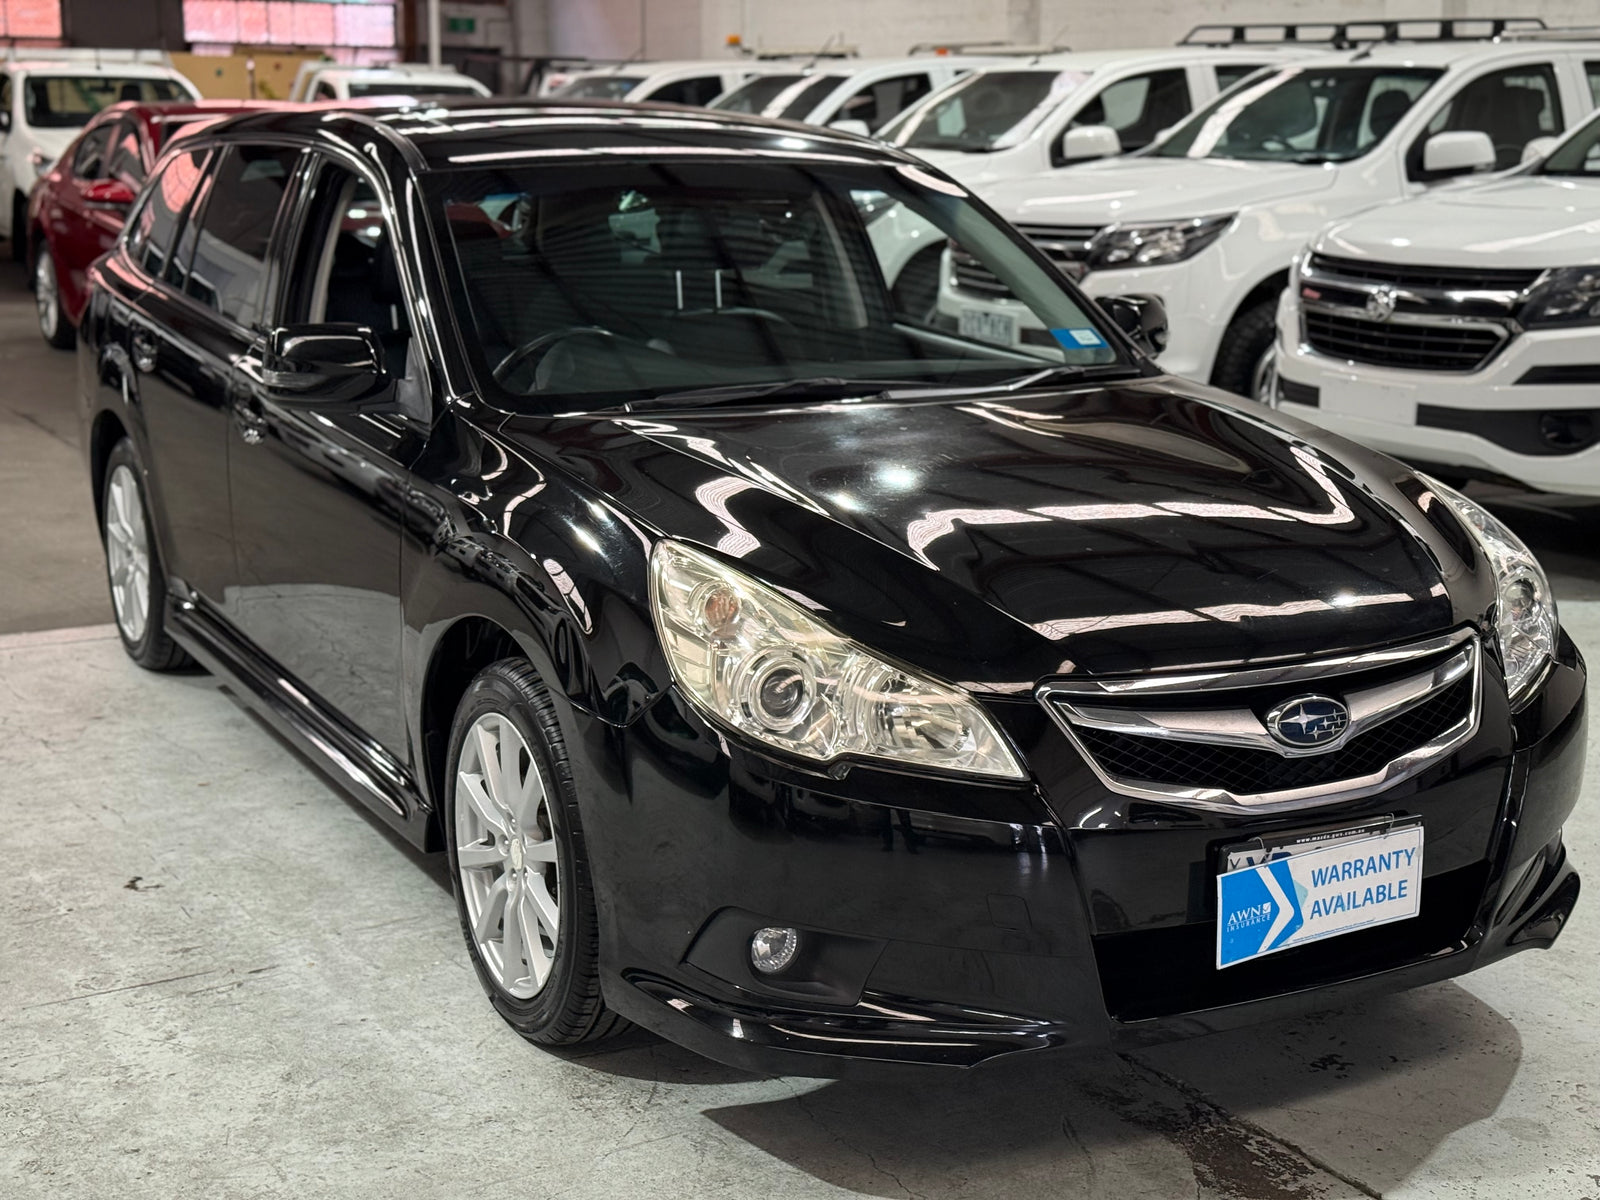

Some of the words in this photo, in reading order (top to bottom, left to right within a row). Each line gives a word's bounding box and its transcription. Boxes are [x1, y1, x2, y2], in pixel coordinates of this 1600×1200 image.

[1311, 847, 1416, 888] WARRANTY
[1228, 904, 1261, 926] AWN
[1310, 879, 1408, 920] AVAILABLE
[1226, 913, 1271, 933] INSURANCE
